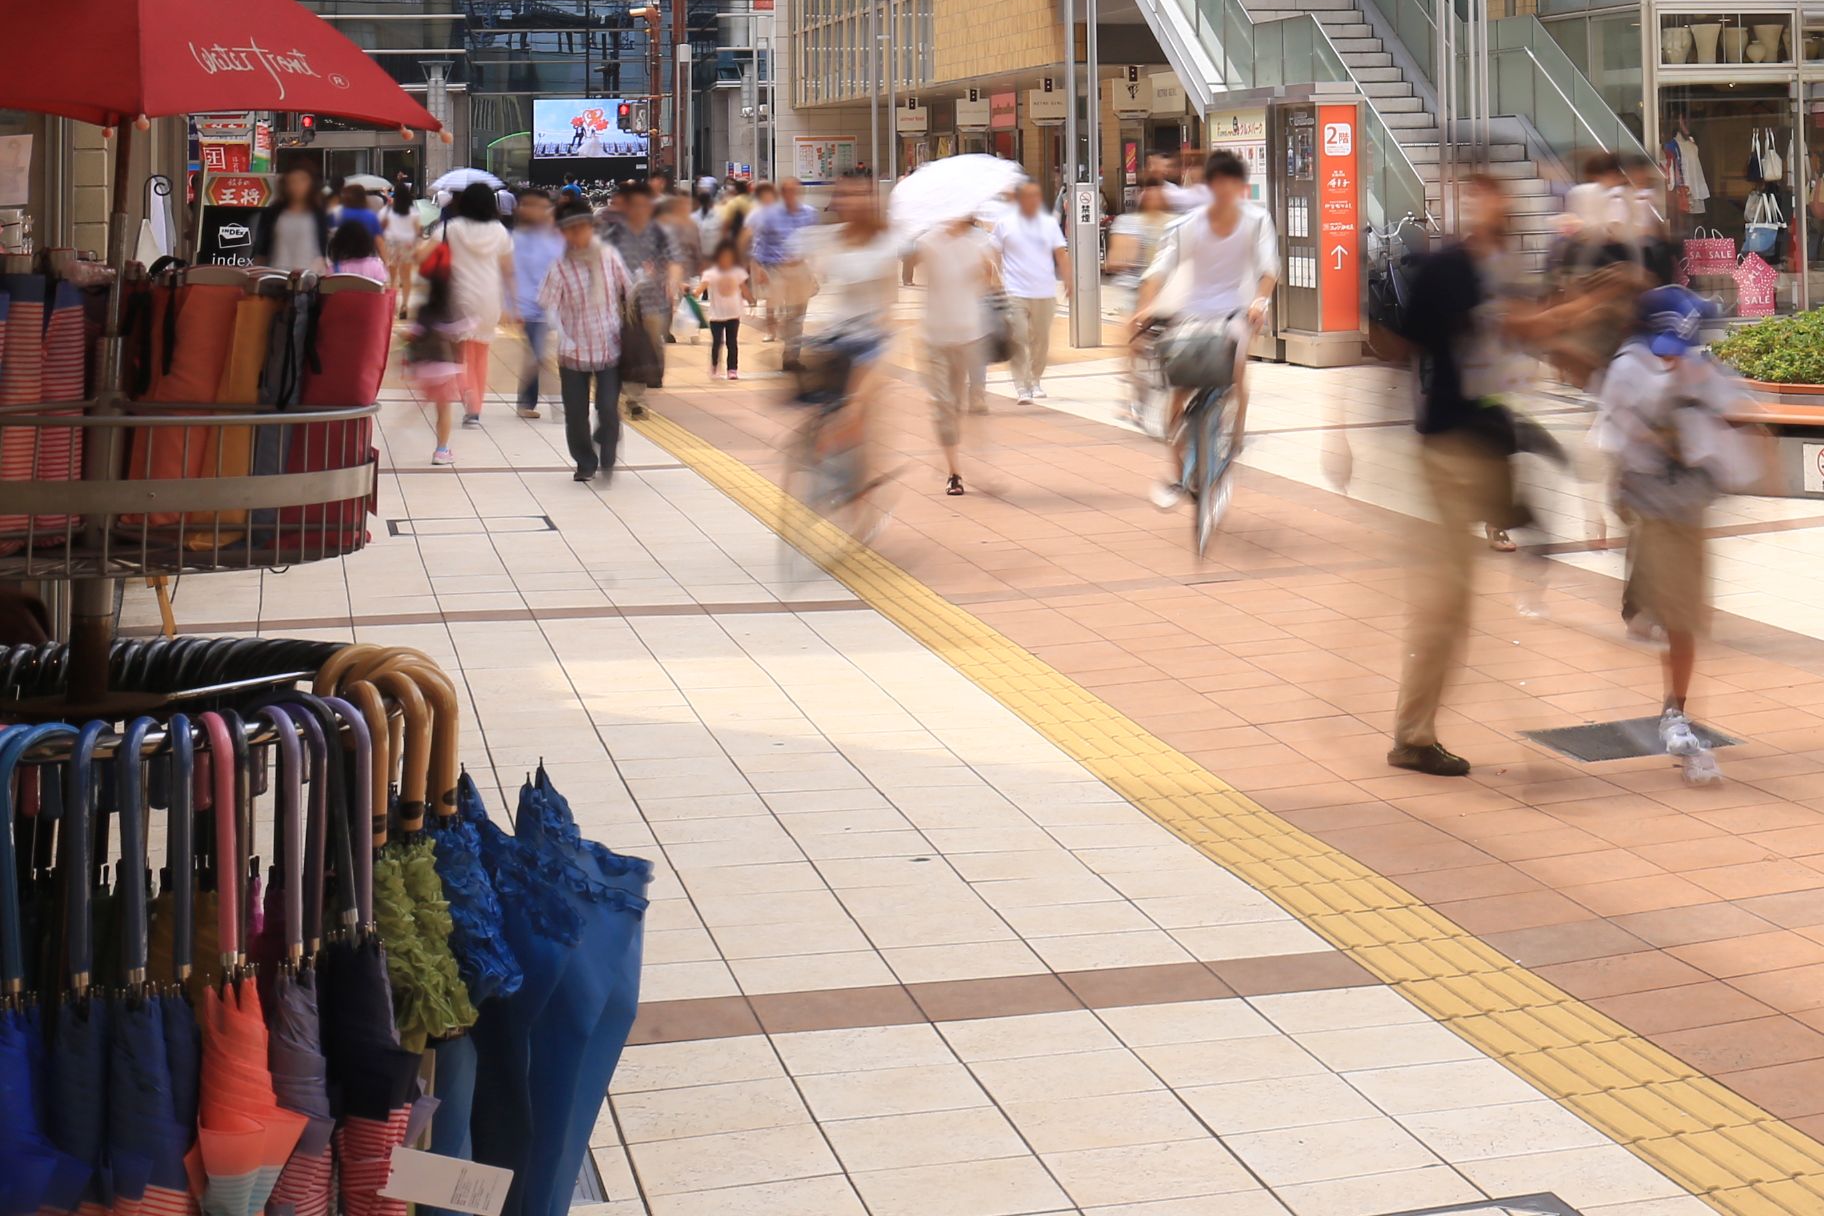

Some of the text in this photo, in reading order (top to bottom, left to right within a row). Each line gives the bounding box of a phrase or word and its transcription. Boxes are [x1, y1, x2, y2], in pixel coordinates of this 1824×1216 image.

[218, 187, 261, 206] 王将
[211, 253, 254, 267] index
[1708, 250, 1733, 259] SALE
[1744, 294, 1771, 305] SALE
